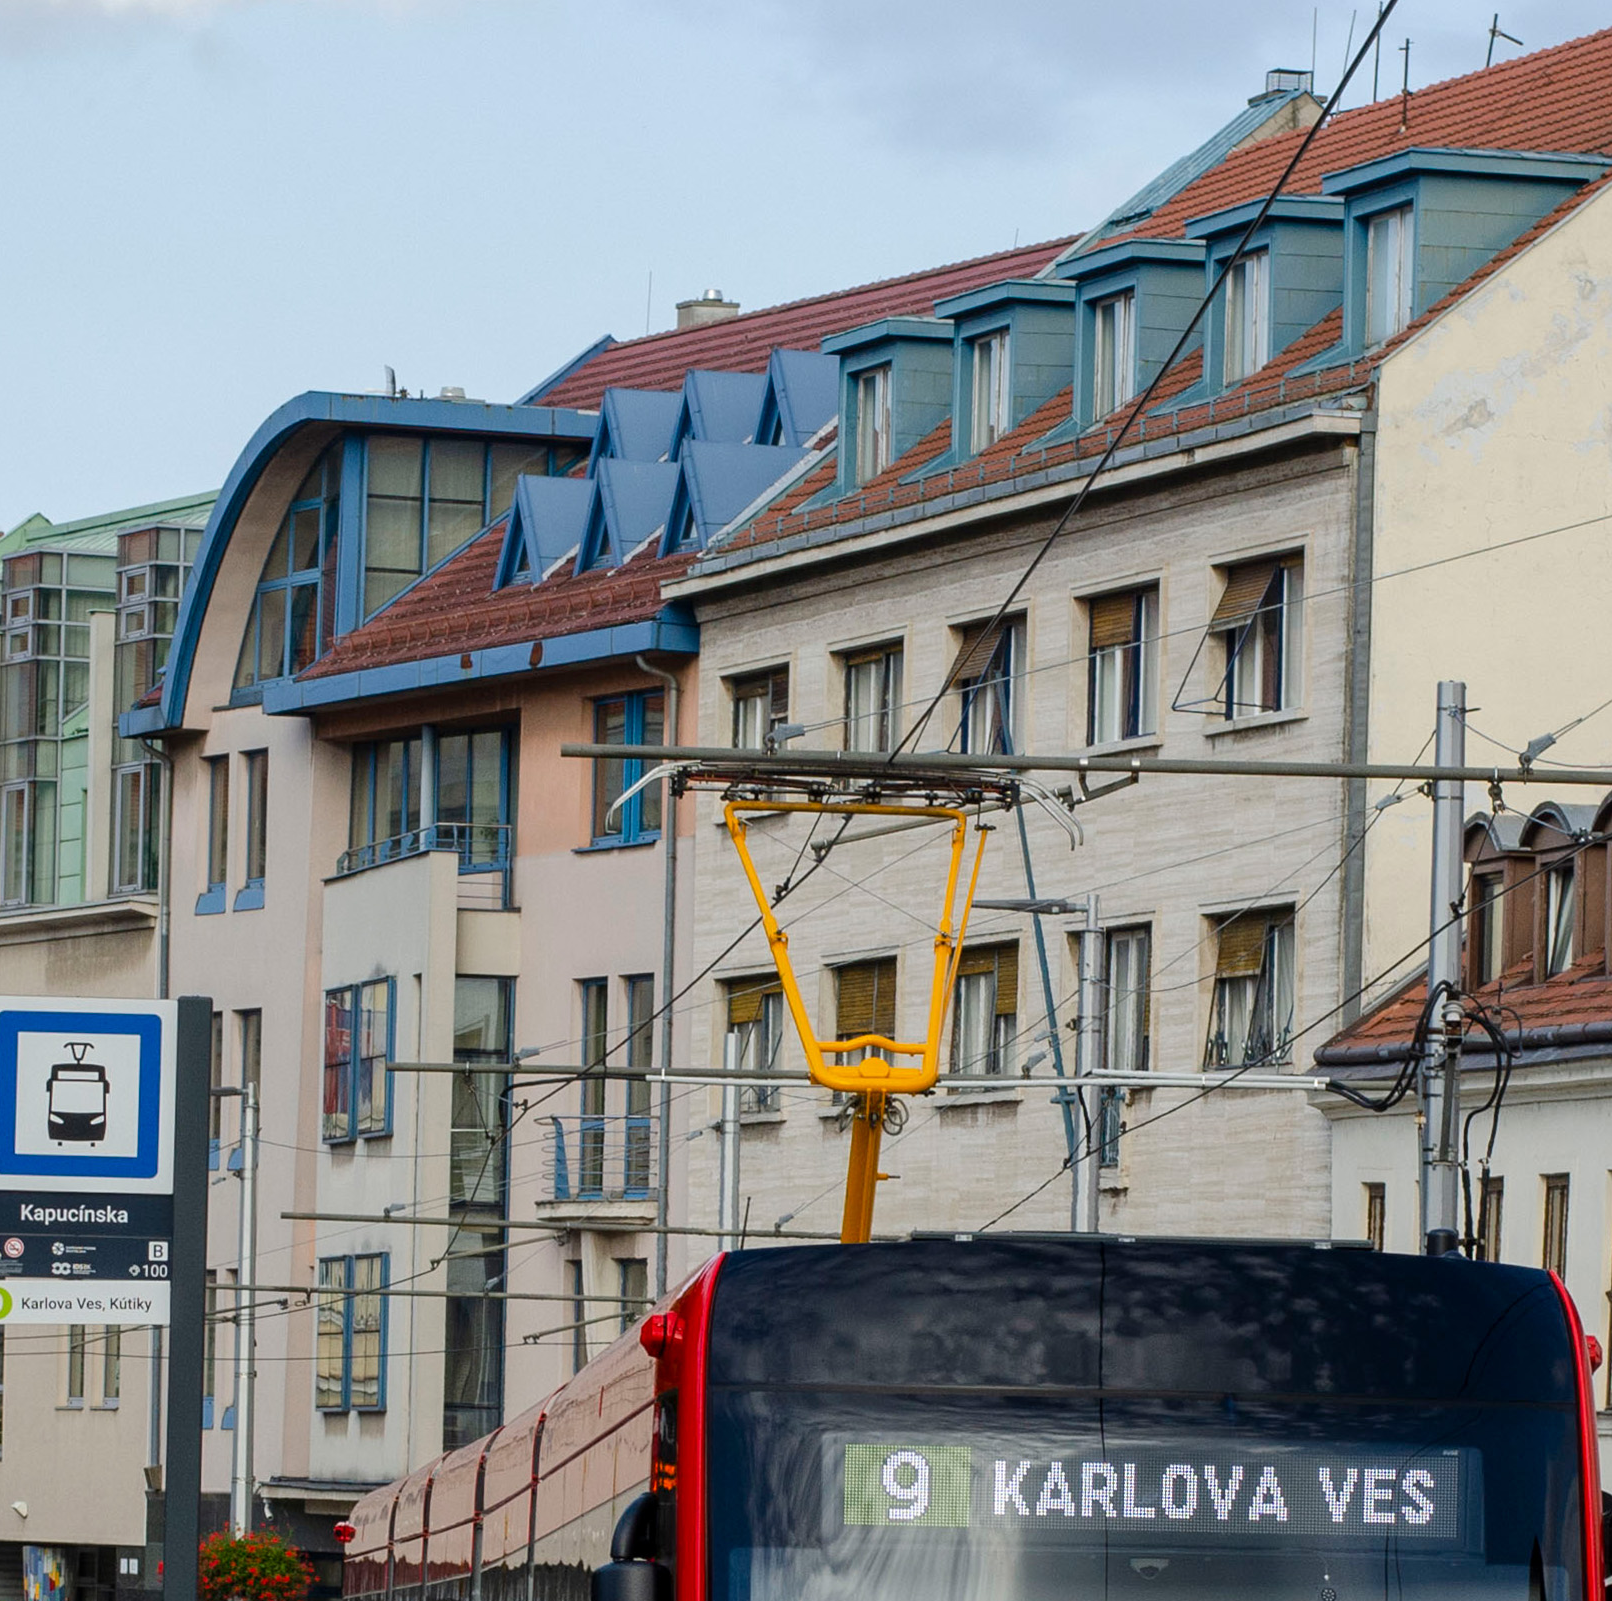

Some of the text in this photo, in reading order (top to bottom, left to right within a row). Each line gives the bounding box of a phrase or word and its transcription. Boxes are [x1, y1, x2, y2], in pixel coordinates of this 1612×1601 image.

[20, 1204, 129, 1226] Kapucínska
[153, 1244, 164, 1258] B
[143, 1264, 168, 1278] 100
[21, 1297, 73, 1310] Karlova
[77, 1297, 106, 1311] Ves,
[110, 1297, 152, 1313] Kútiky
[881, 1450, 1437, 1526] 9 KARLOVA VES
